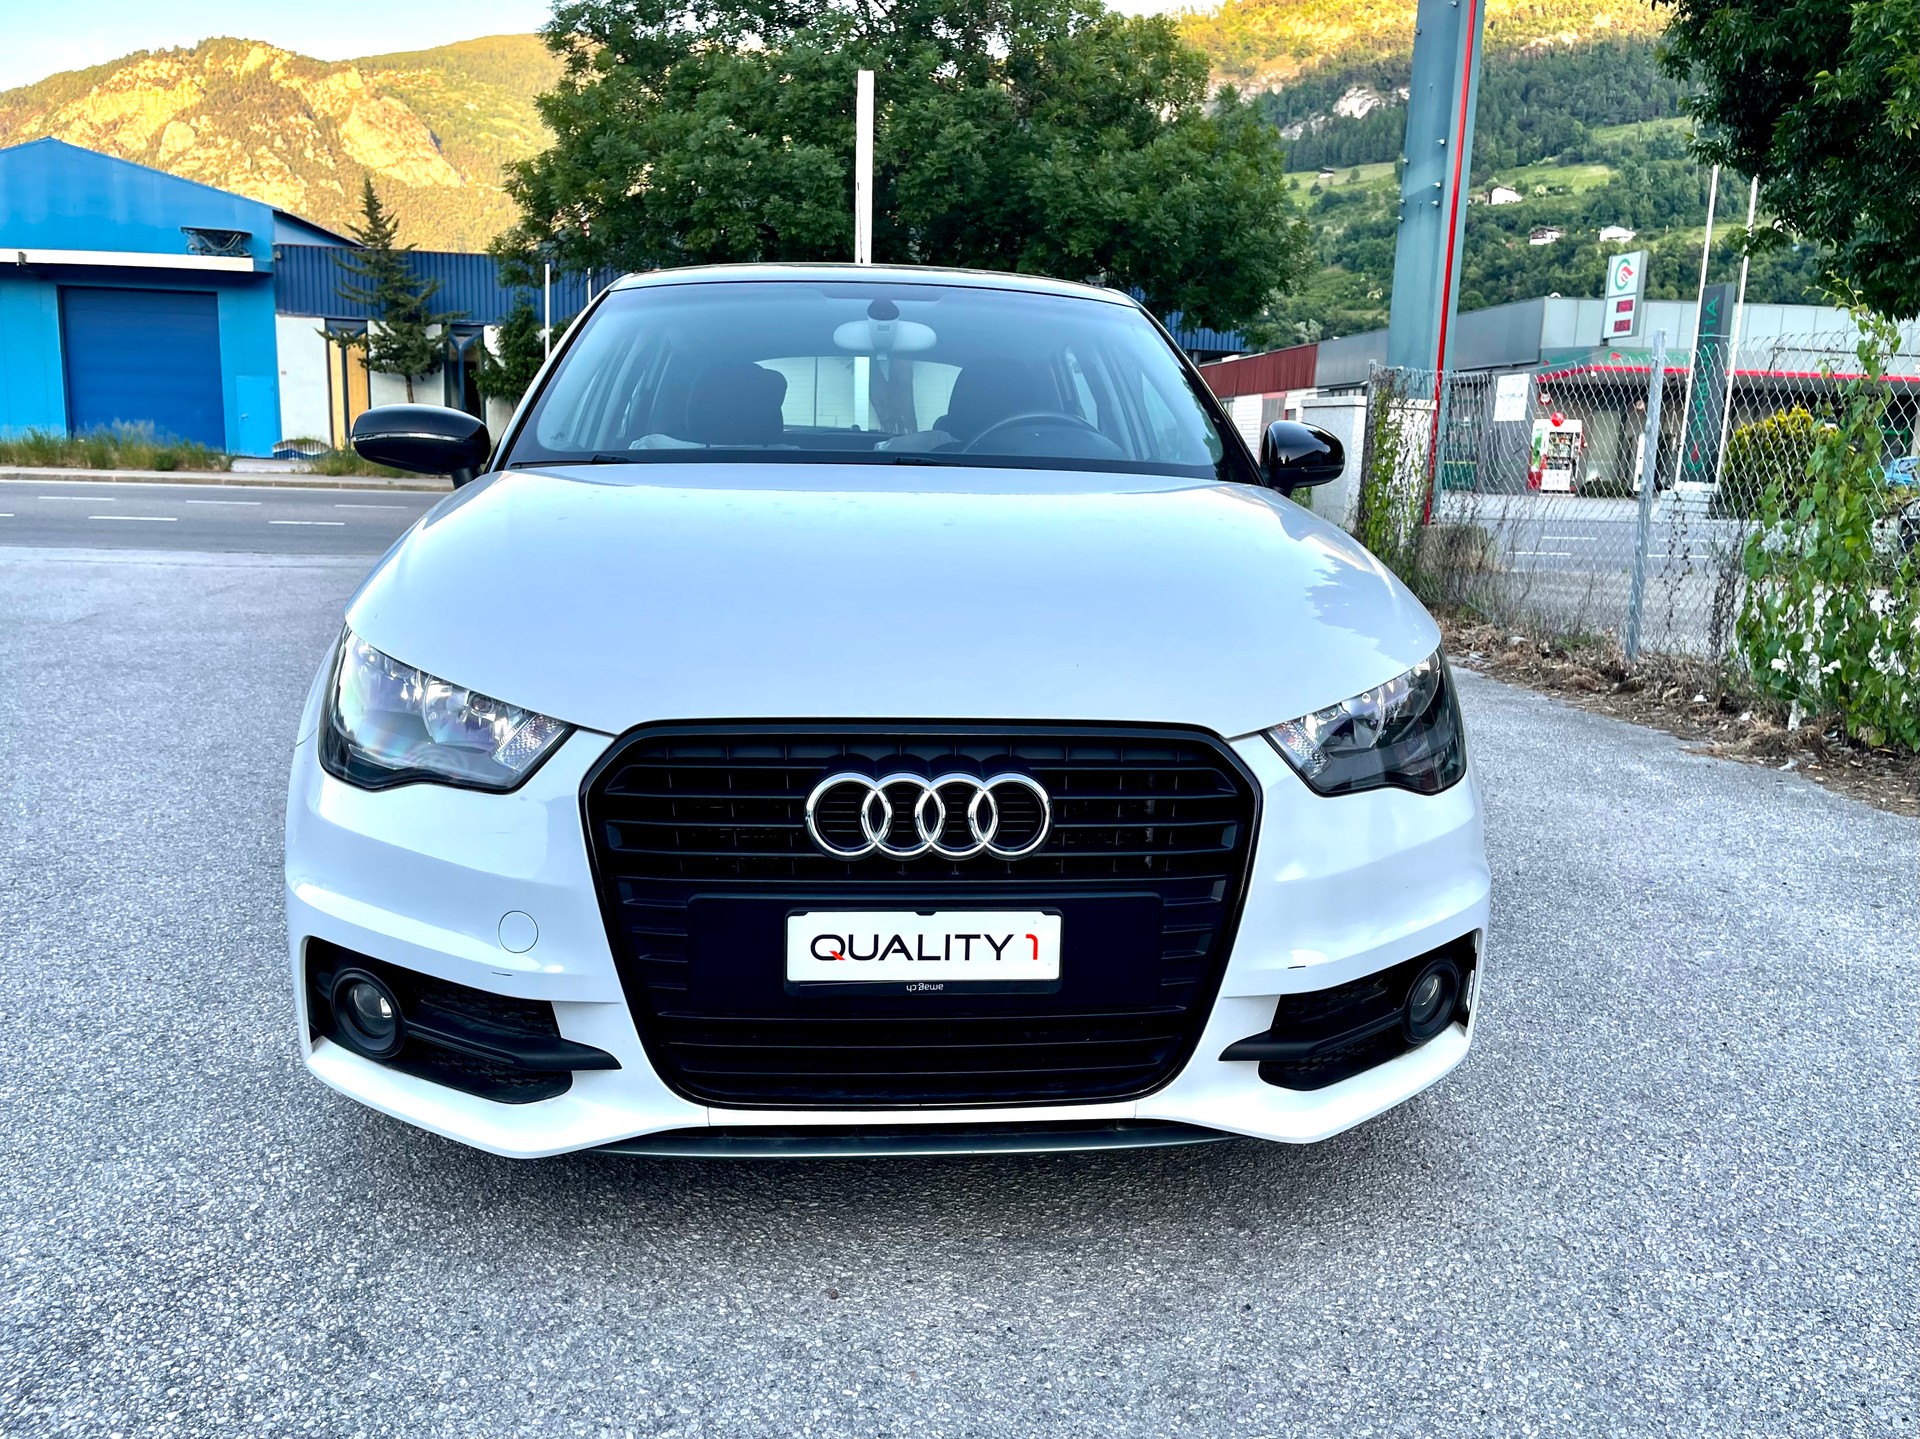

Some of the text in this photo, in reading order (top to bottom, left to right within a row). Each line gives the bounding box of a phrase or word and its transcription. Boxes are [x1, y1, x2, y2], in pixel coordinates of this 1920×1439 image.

[810, 934, 1039, 961] QUALITY 1
[906, 982, 944, 992] amag.ch
